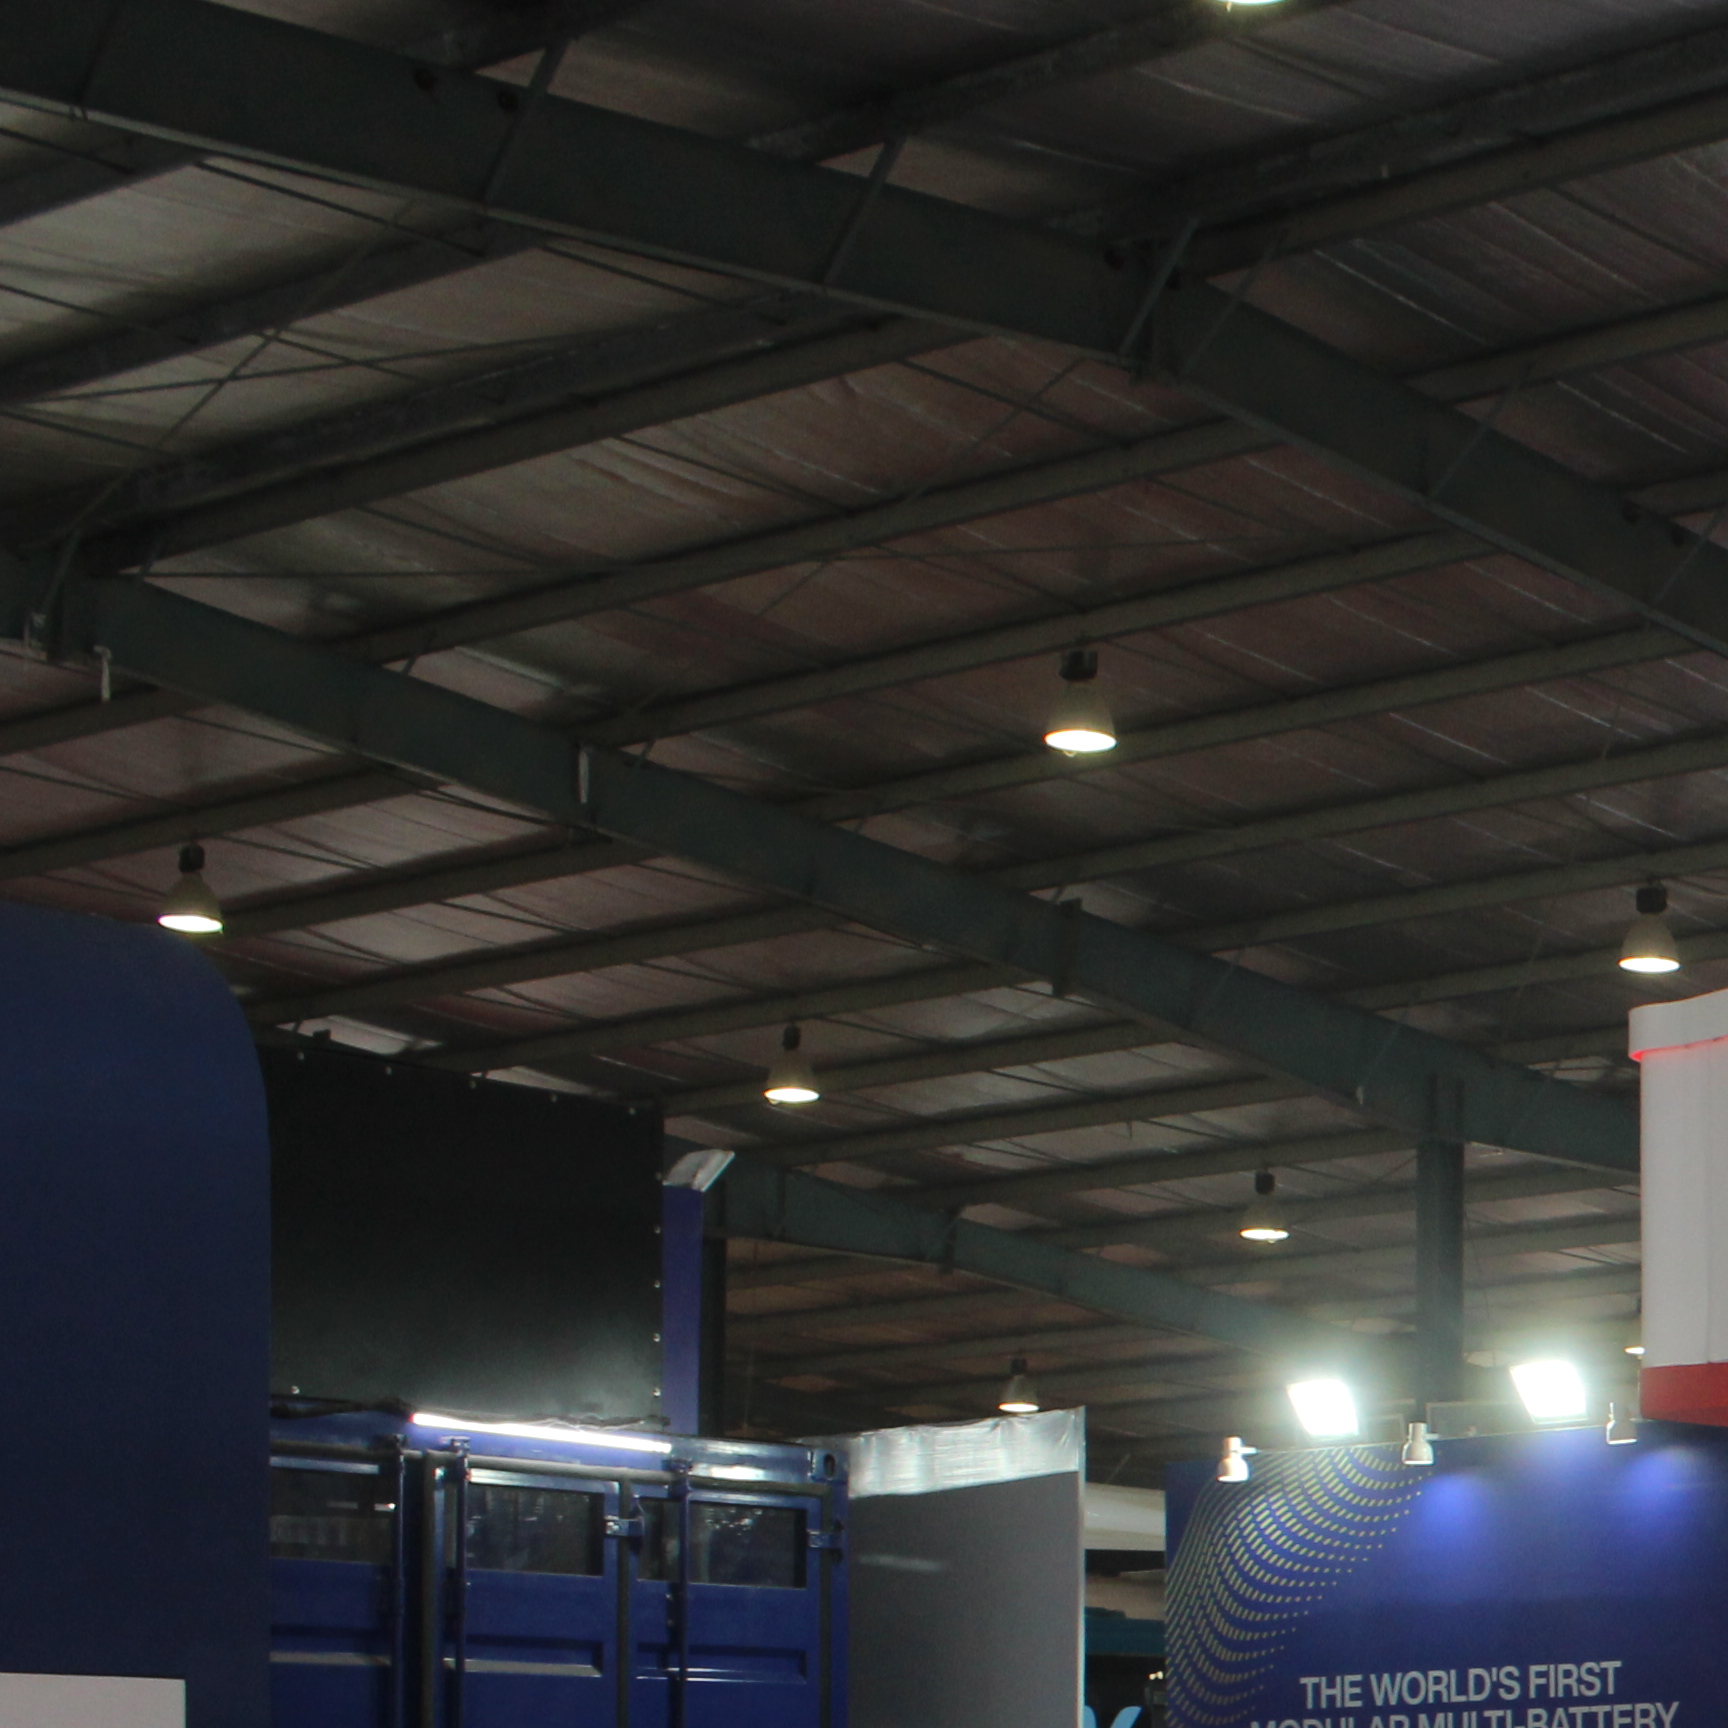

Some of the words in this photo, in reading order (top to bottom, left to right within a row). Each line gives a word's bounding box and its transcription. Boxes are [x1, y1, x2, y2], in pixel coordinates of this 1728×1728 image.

[1300, 1674, 1364, 1710] THE
[1370, 1666, 1521, 1707] WORLD'S
[1528, 1660, 1622, 1699] FIRST
